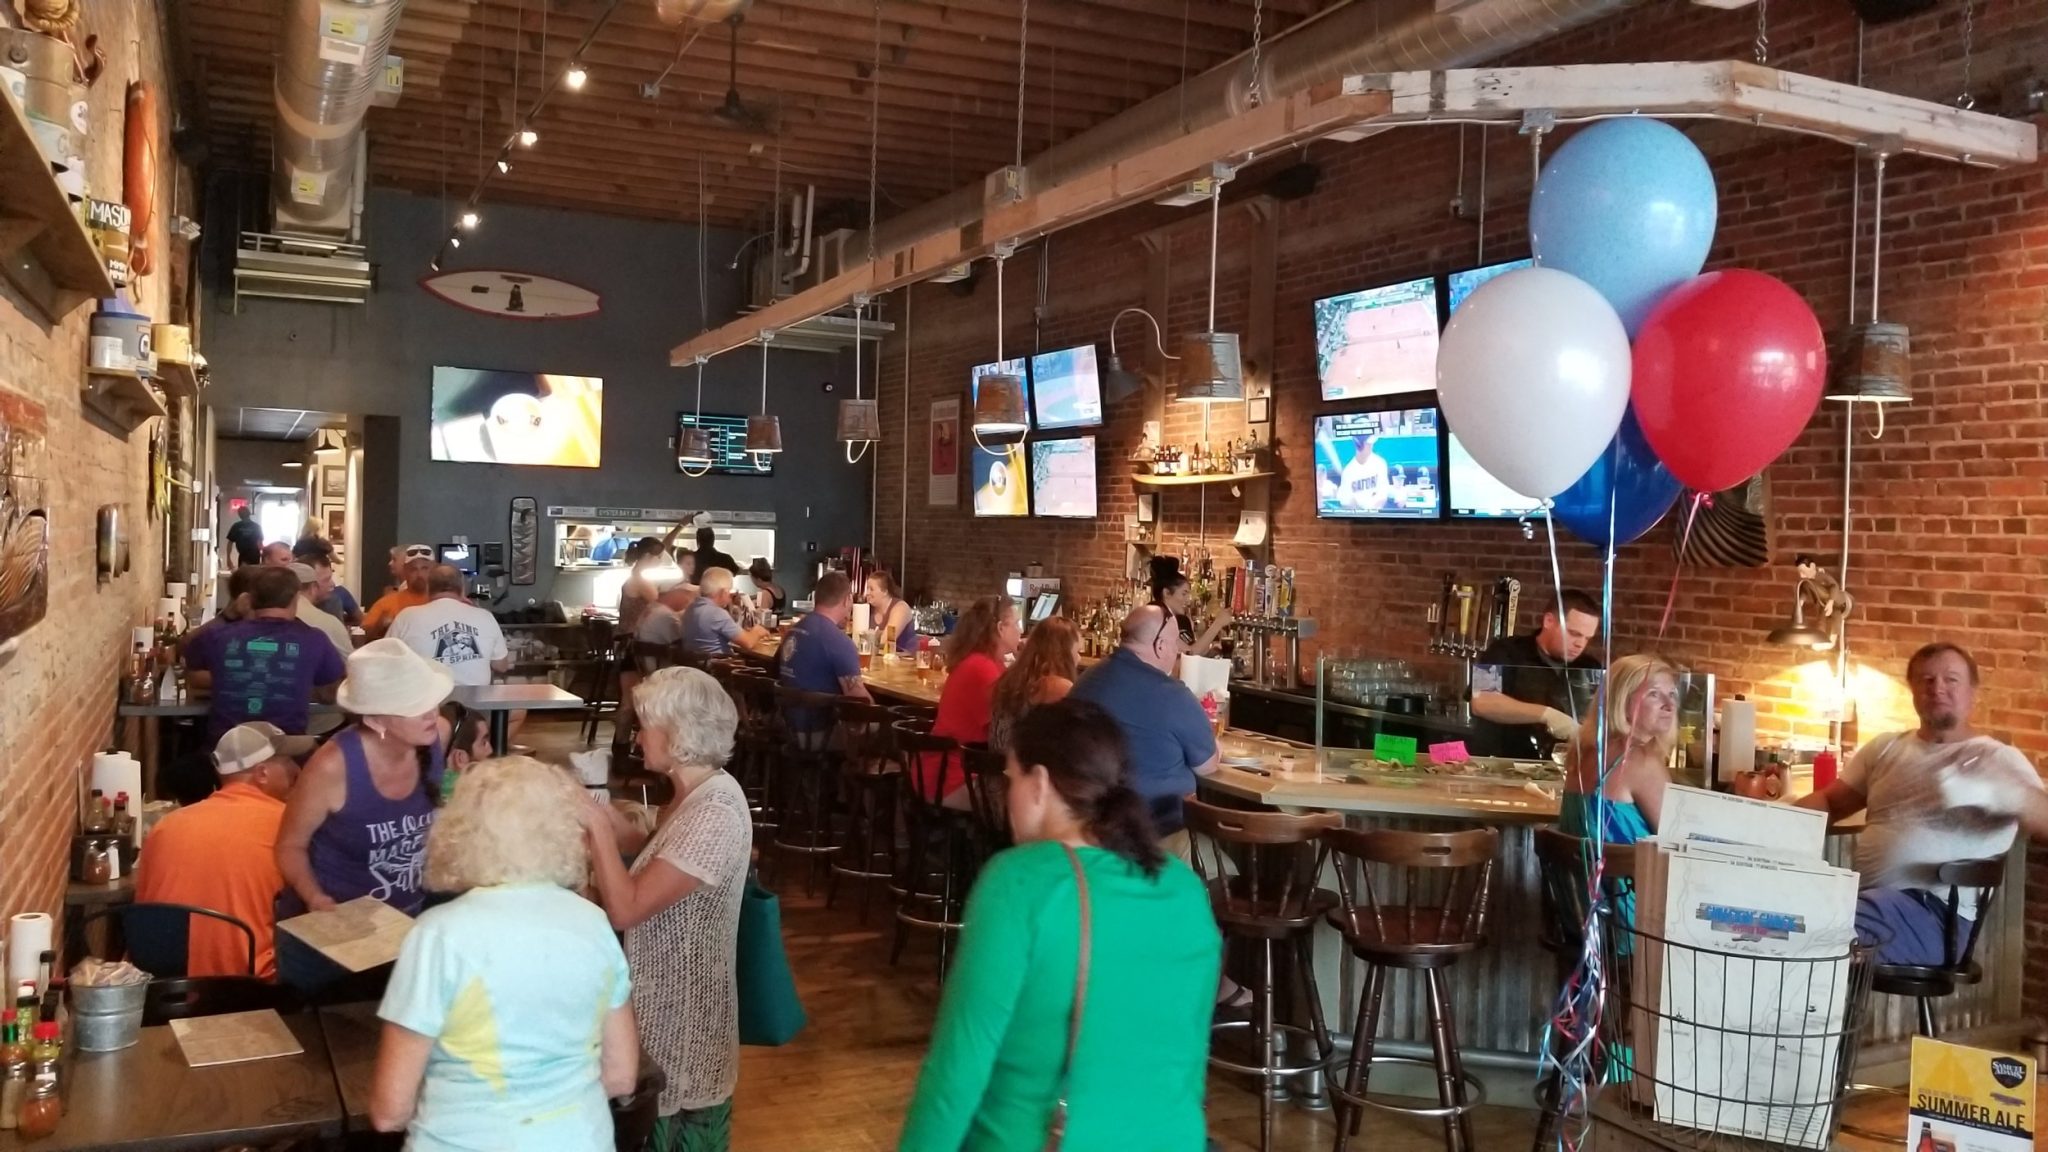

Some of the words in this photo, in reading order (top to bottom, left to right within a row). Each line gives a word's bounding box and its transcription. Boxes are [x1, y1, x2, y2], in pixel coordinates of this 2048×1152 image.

[430, 623, 449, 640] THE
[453, 621, 479, 637] KING
[366, 820, 398, 844] THE
[1992, 1060, 2026, 1075] SAMUEL
[1917, 1093, 1991, 1124] SUMMER
[1995, 1109, 2026, 1130] ALE
